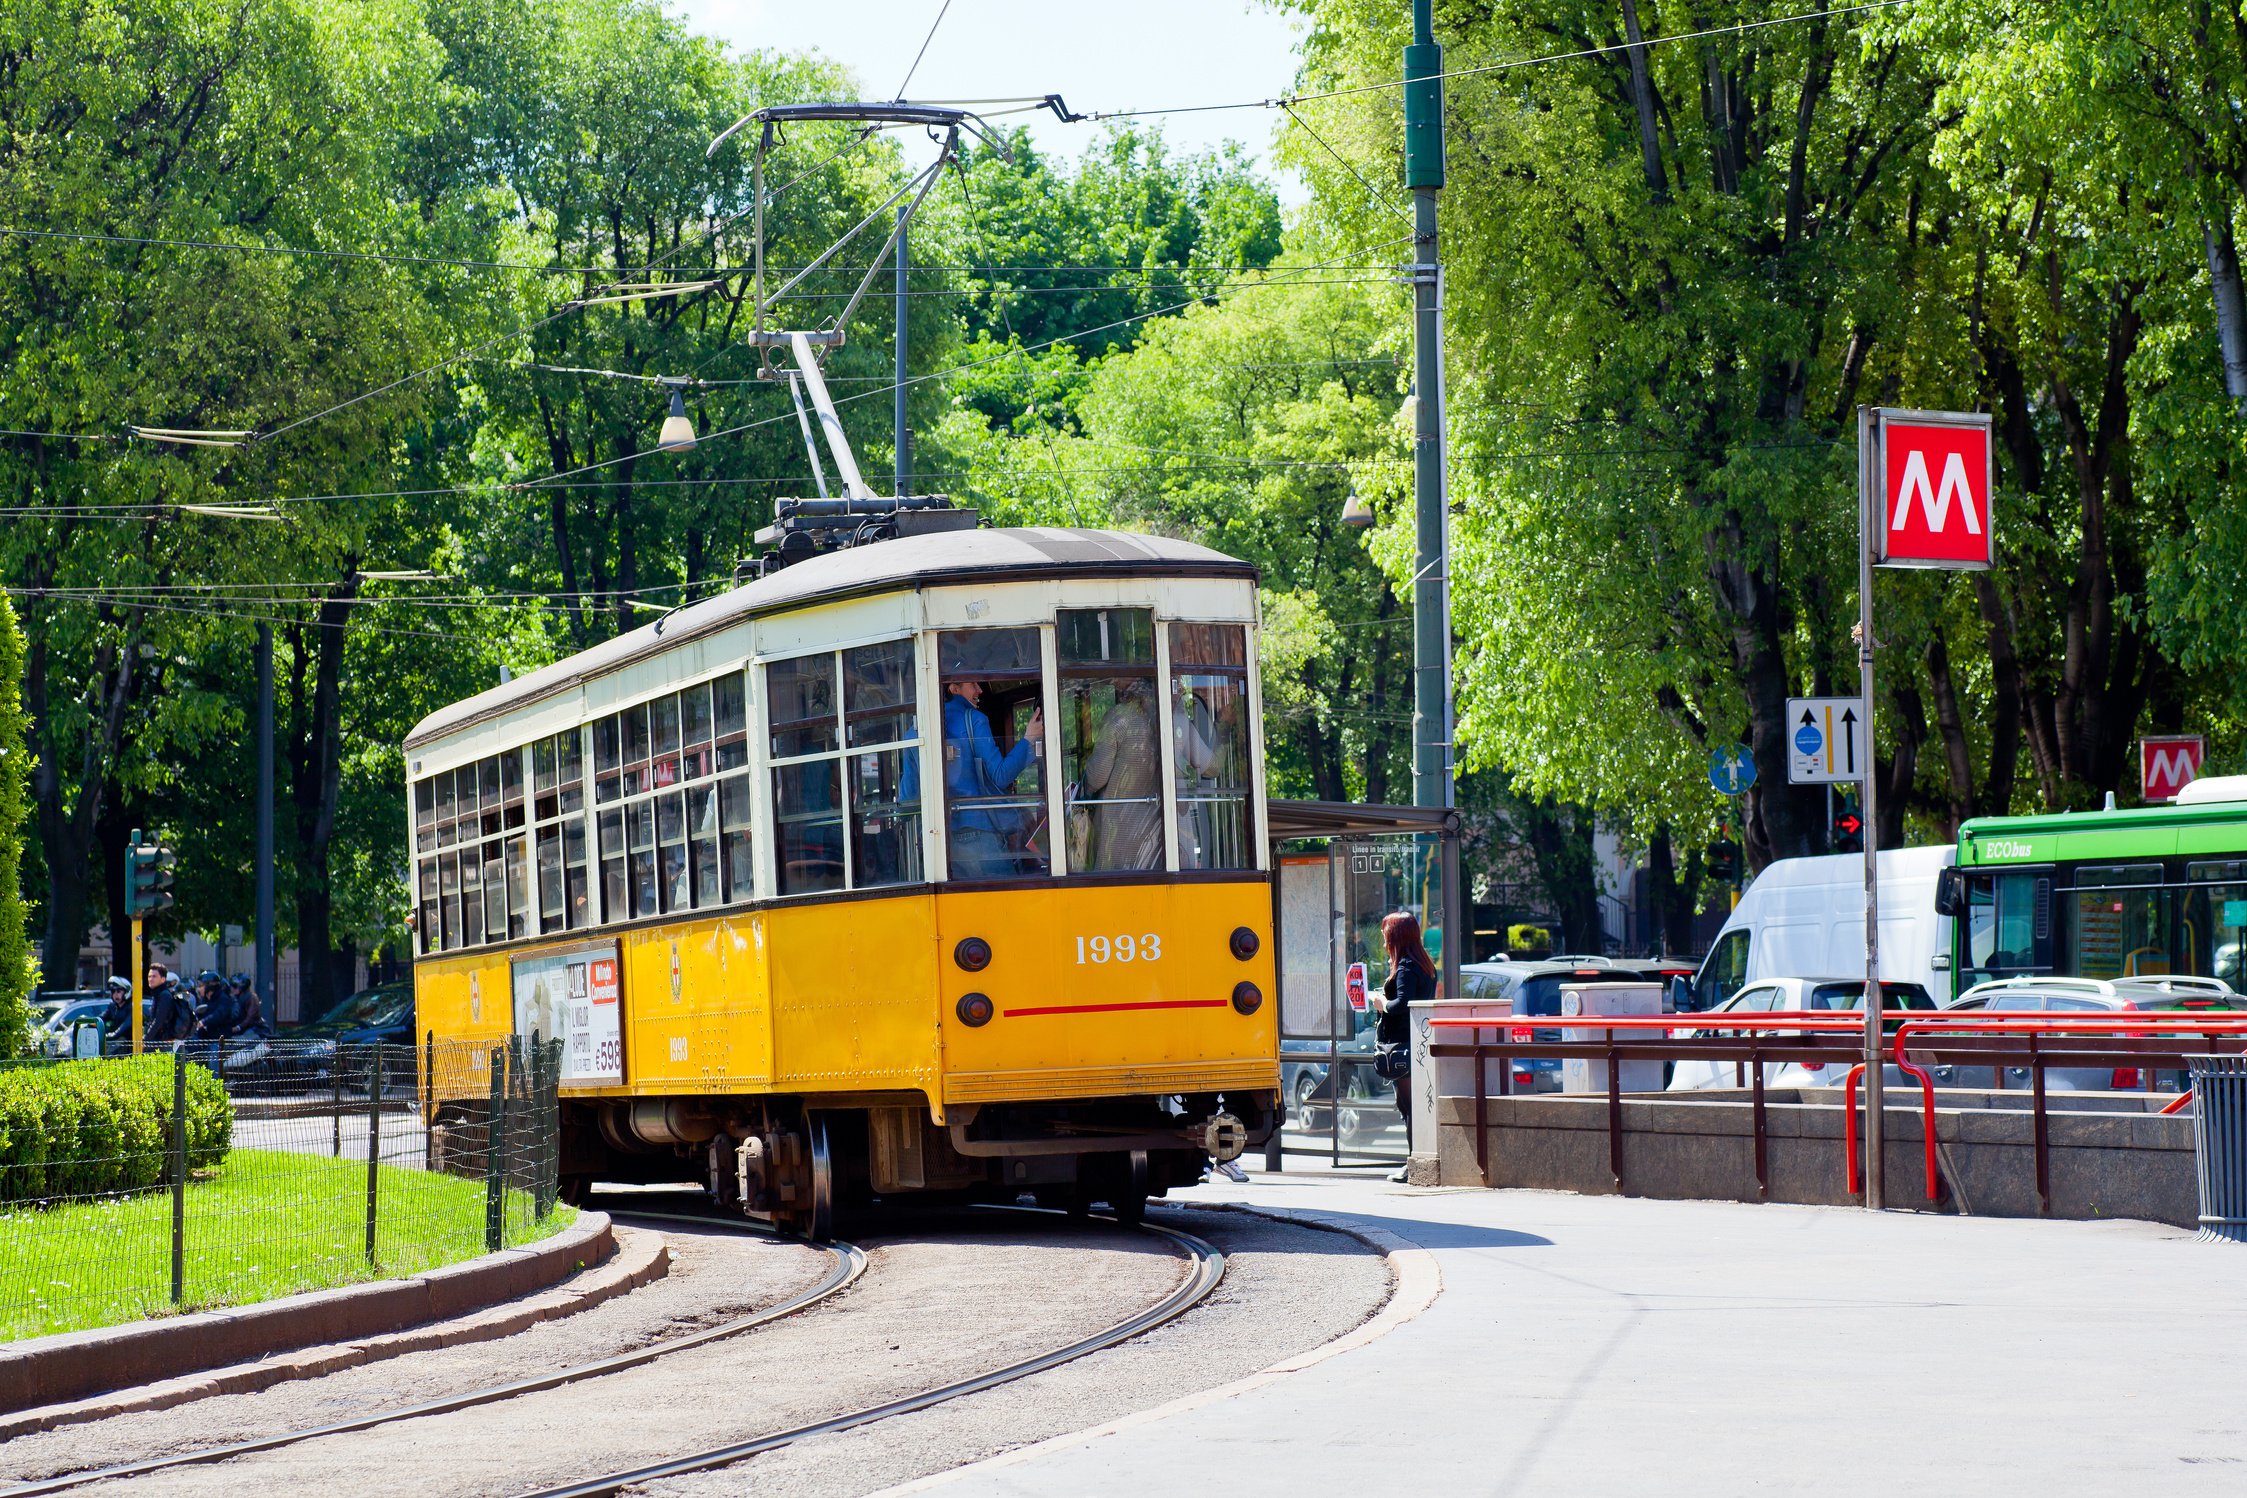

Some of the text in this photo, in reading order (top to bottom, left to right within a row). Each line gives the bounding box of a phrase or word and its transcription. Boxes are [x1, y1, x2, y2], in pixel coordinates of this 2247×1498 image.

[1892, 450, 1981, 535] M
[1097, 611, 1110, 661] 1
[2147, 749, 2196, 787] M
[1352, 845, 1369, 853] Linee
[1370, 844, 1377, 853] in
[1985, 841, 2032, 858] ECObus
[1076, 933, 1162, 965] 1993
[670, 1036, 688, 1062] 1993
